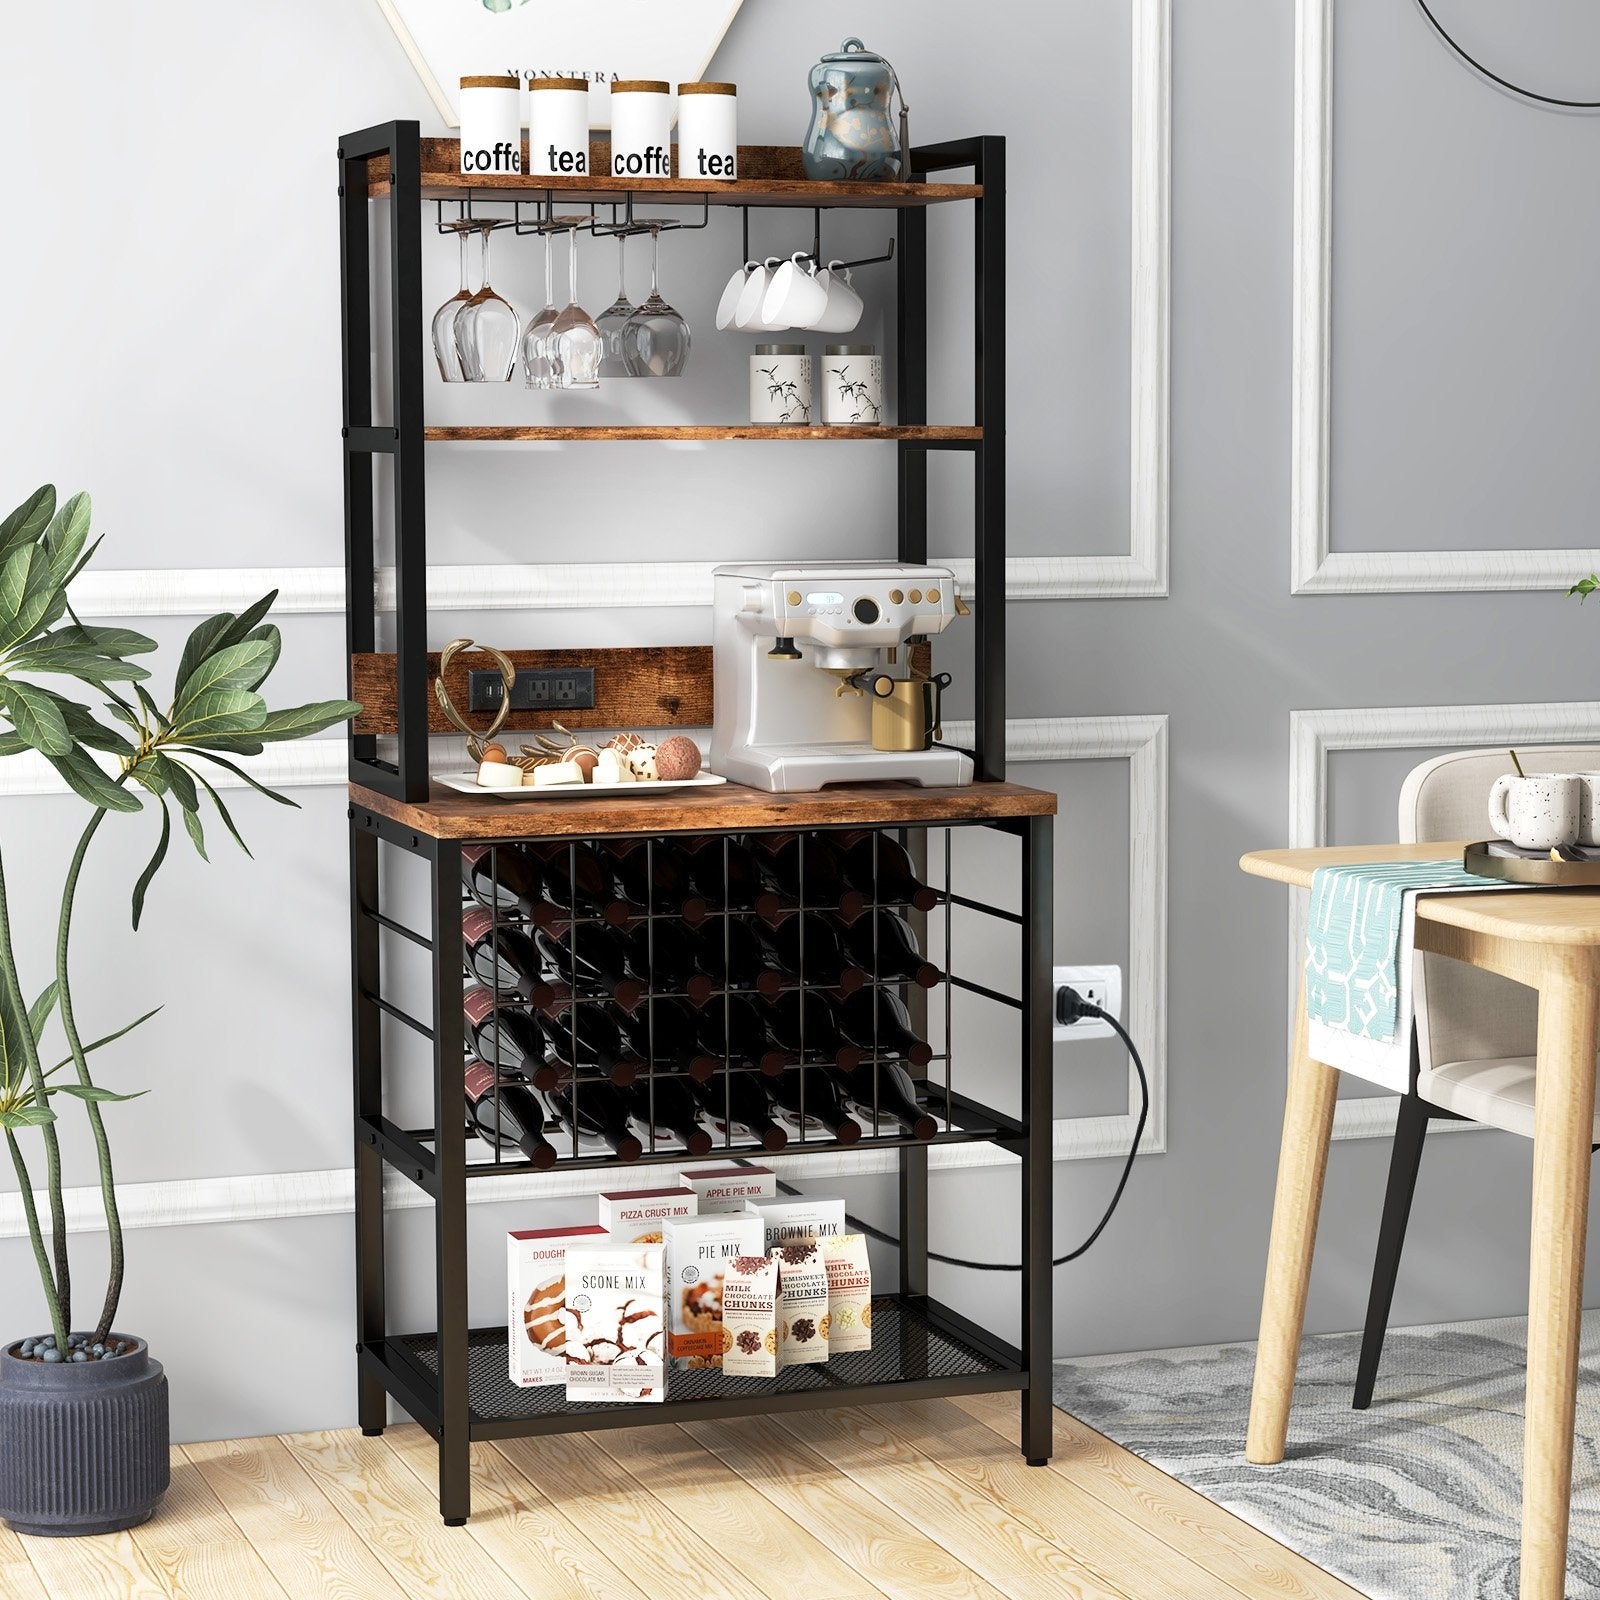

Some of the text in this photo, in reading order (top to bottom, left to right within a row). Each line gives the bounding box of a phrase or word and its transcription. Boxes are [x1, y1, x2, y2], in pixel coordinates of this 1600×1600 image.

[507, 69, 619, 83] MONSTERA
[548, 144, 586, 173] tea
[698, 148, 734, 176] tea
[706, 1186, 762, 1198] APPLE PIE MIX
[620, 1206, 689, 1220] PIZZA CRUST MIX
[766, 1223, 838, 1241] BROWNIE MIX
[698, 1243, 741, 1259] PIE MIX
[781, 1273, 825, 1283] EMISWEET
[827, 1269, 869, 1279] HOCOLATE
[582, 1275, 646, 1289] SCONE MIX
[724, 1300, 773, 1309] CHUNKS
